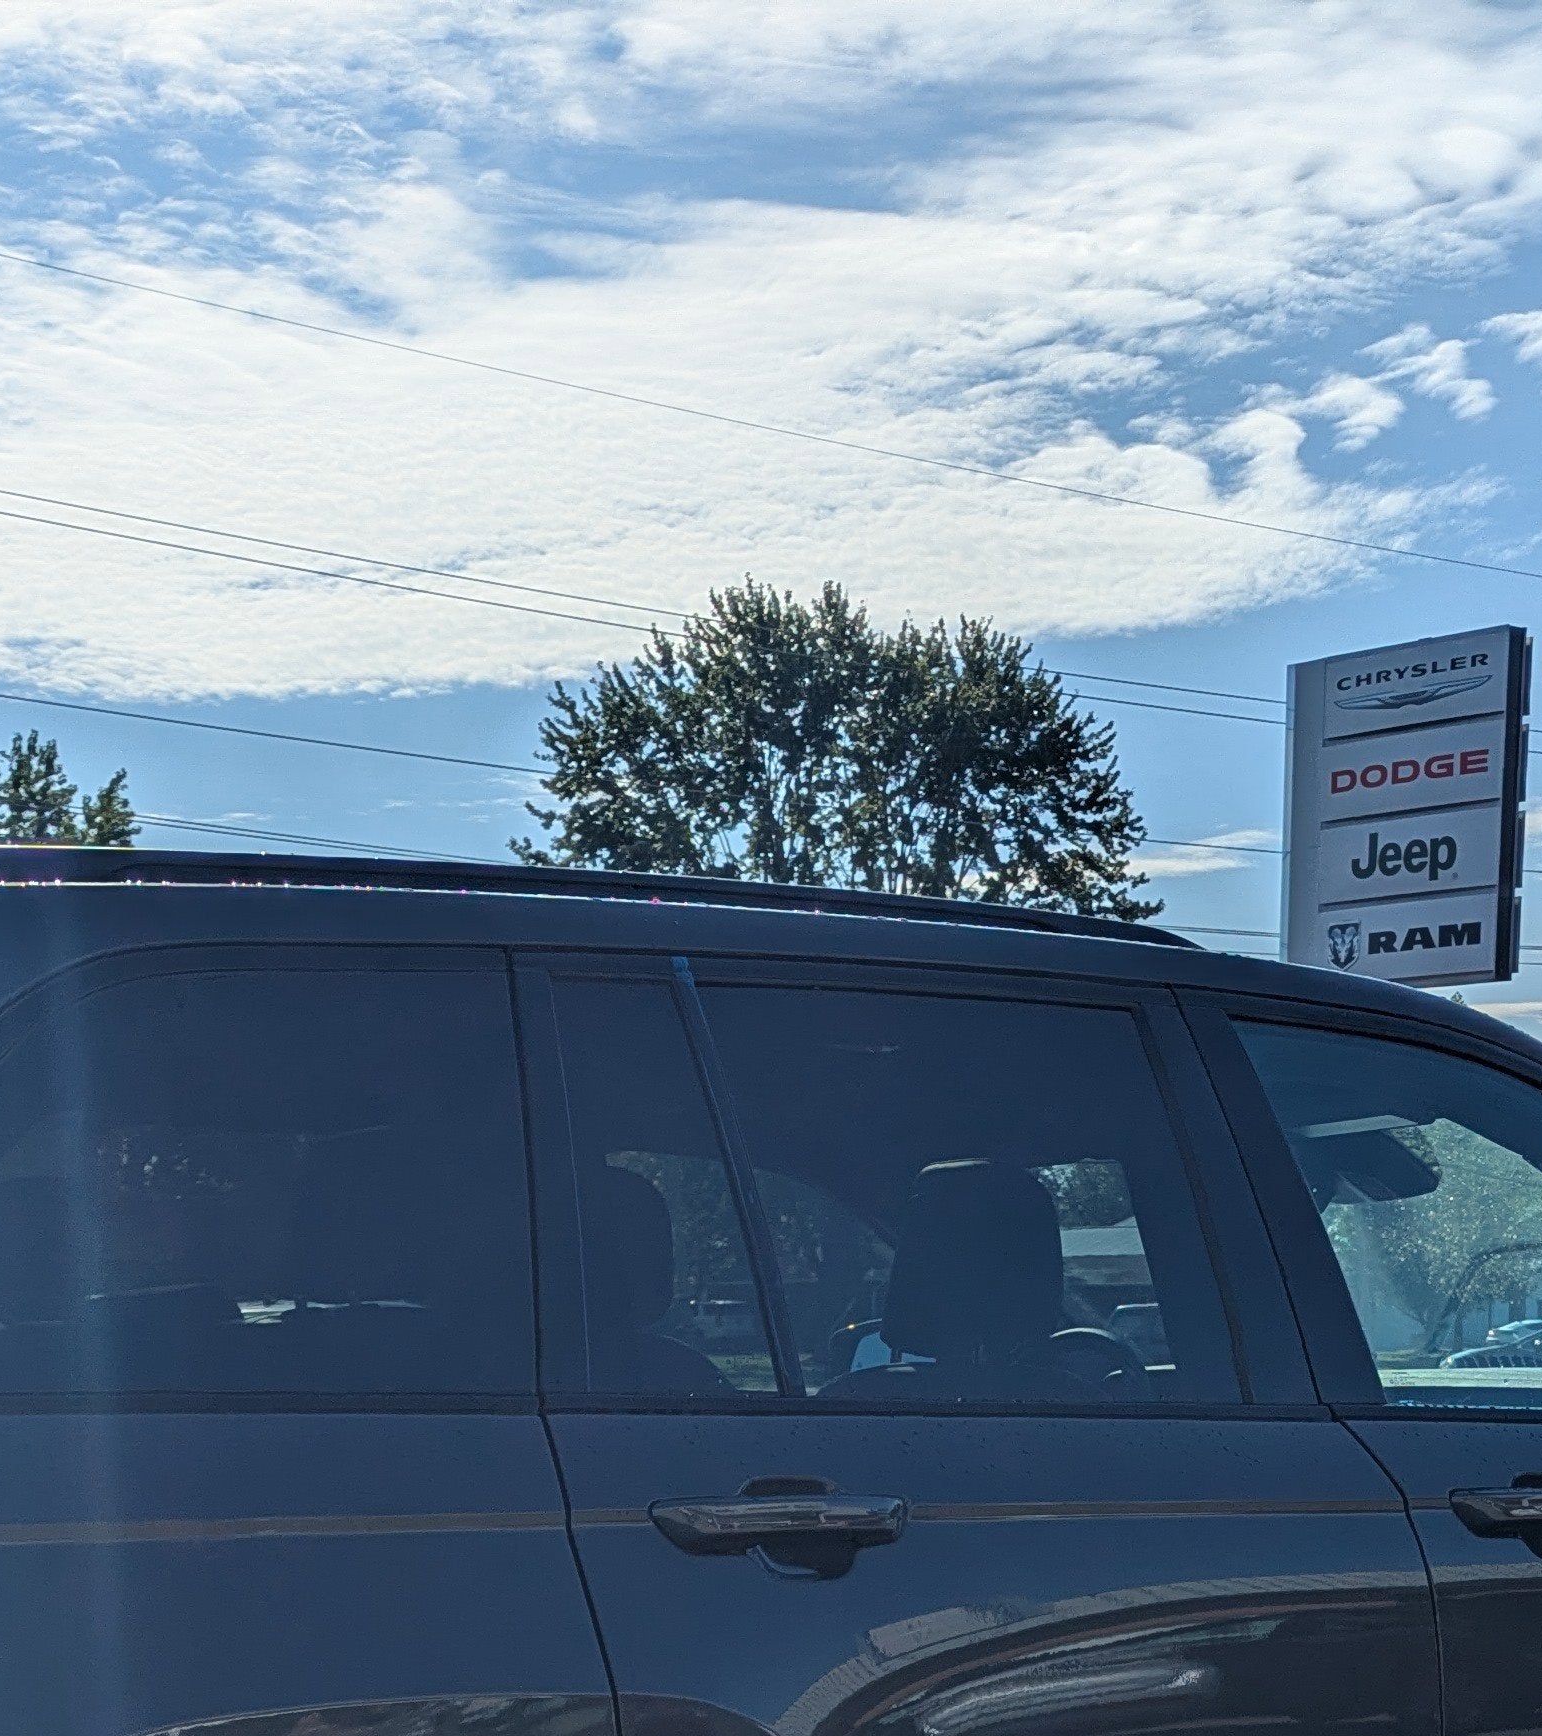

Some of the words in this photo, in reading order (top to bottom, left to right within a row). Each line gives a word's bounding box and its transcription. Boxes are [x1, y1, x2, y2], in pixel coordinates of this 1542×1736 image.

[1336, 653, 1489, 691] CHRYSLER
[1330, 749, 1489, 794] DODGE
[1351, 832, 1457, 881] Jeep
[1367, 921, 1482, 955] RAM
